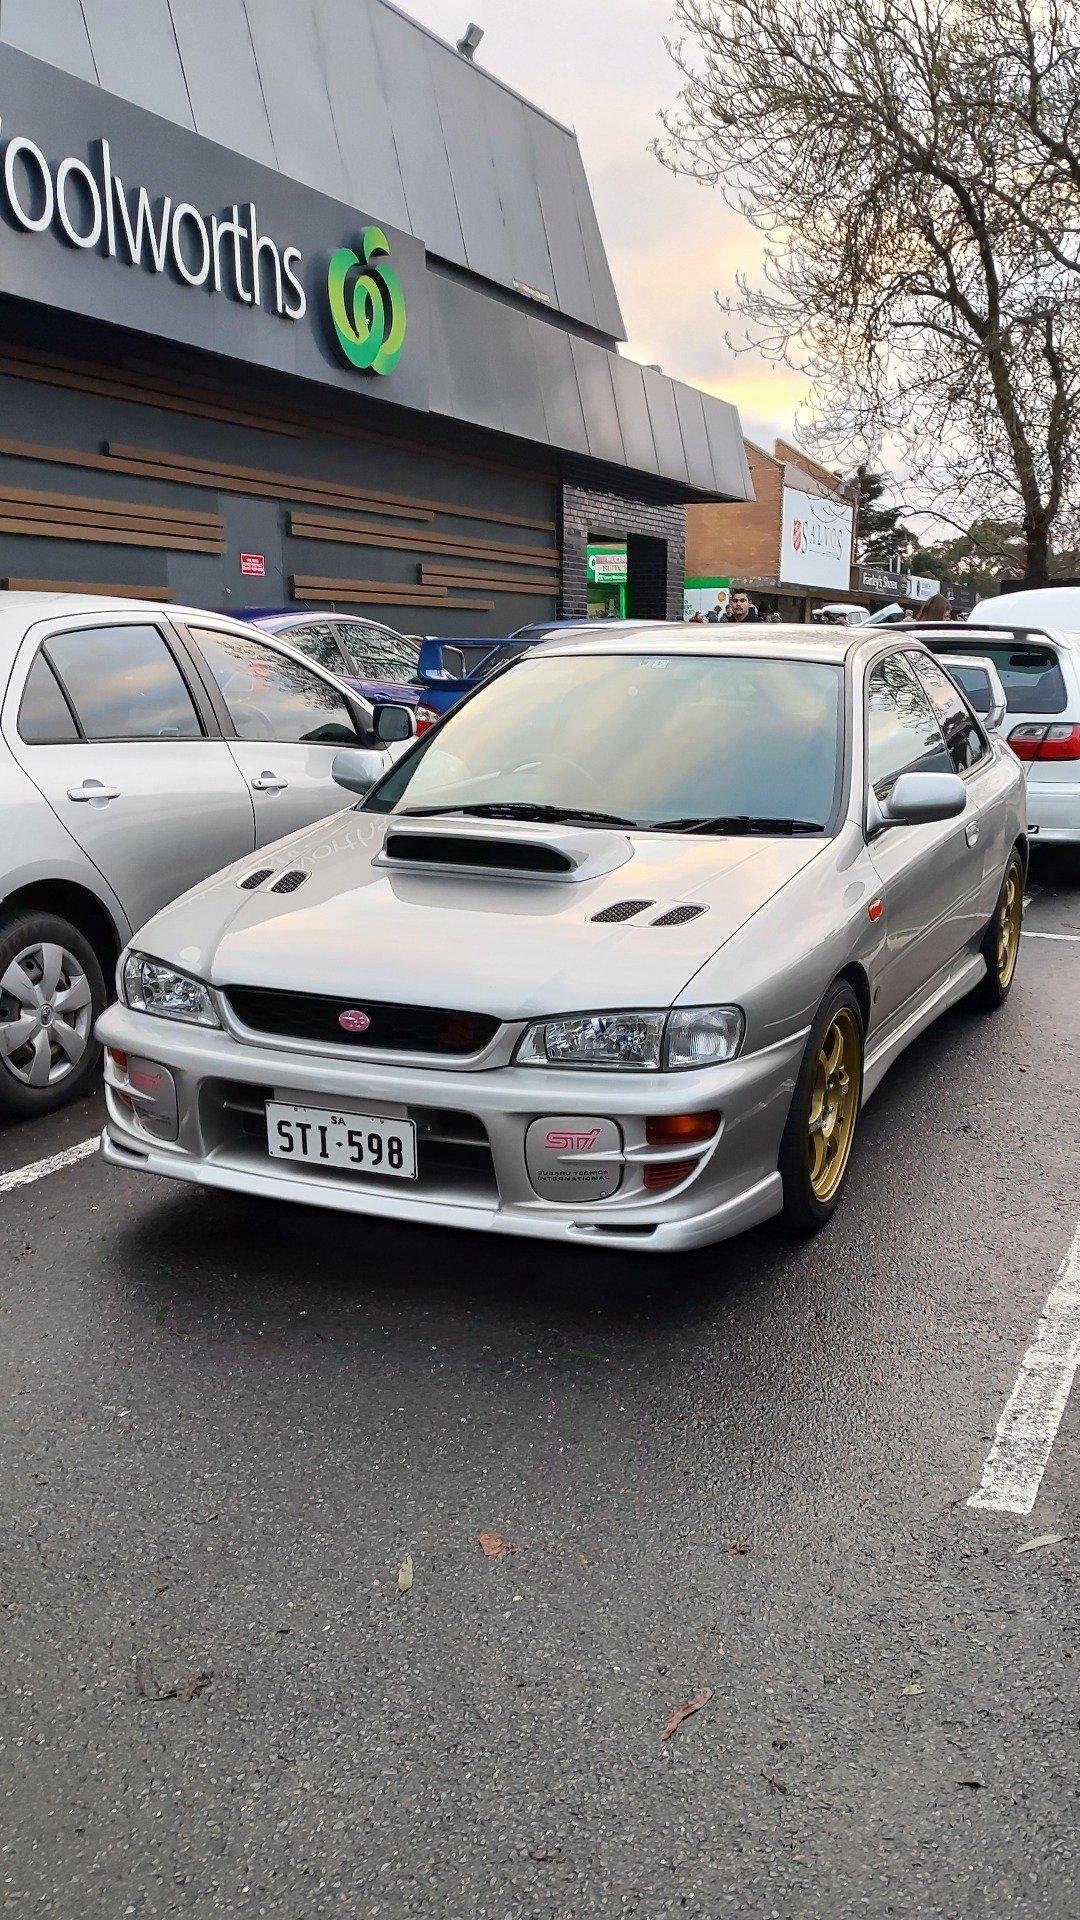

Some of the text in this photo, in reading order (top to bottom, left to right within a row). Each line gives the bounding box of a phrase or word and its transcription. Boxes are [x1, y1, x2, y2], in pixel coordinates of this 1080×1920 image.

[0, 118, 307, 319] oolworths
[801, 521, 842, 560] SALVOS
[330, 1115, 346, 1126] SA
